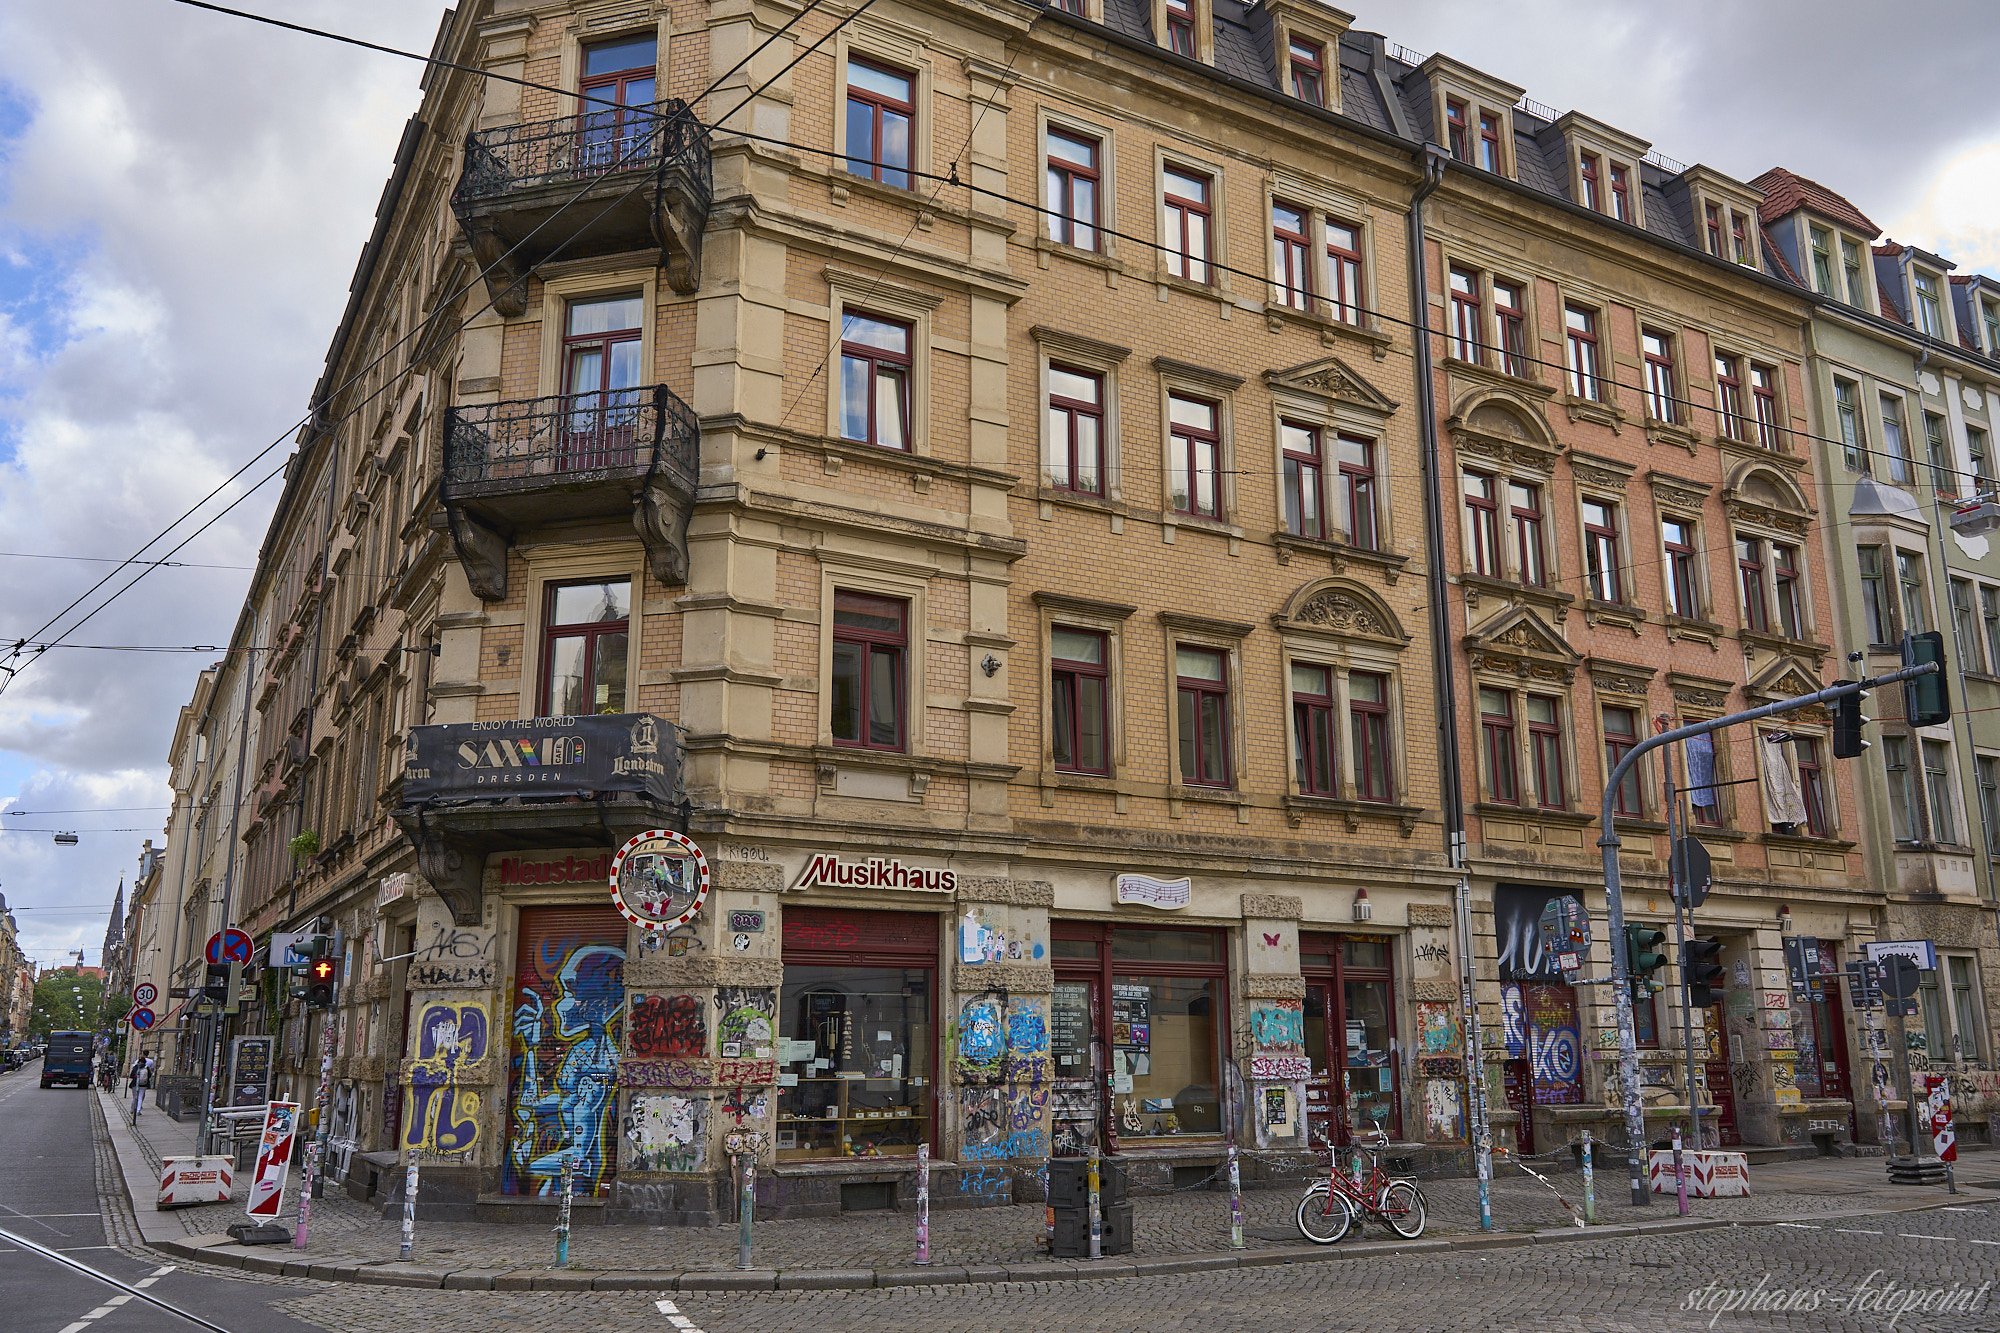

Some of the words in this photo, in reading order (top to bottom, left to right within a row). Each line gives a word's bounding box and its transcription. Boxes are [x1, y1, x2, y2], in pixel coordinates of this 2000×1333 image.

[472, 720, 509, 732] ENJOY
[511, 719, 532, 730] THE
[535, 717, 576, 729] WORLD
[554, 743, 564, 765] CAFE
[575, 743, 583, 764] BAR
[611, 755, 665, 776] Landskron
[477, 772, 562, 784] DRESDEN
[501, 854, 612, 885] Neustad
[797, 855, 956, 892] Musikhaus
[138, 988, 153, 1000] 30
